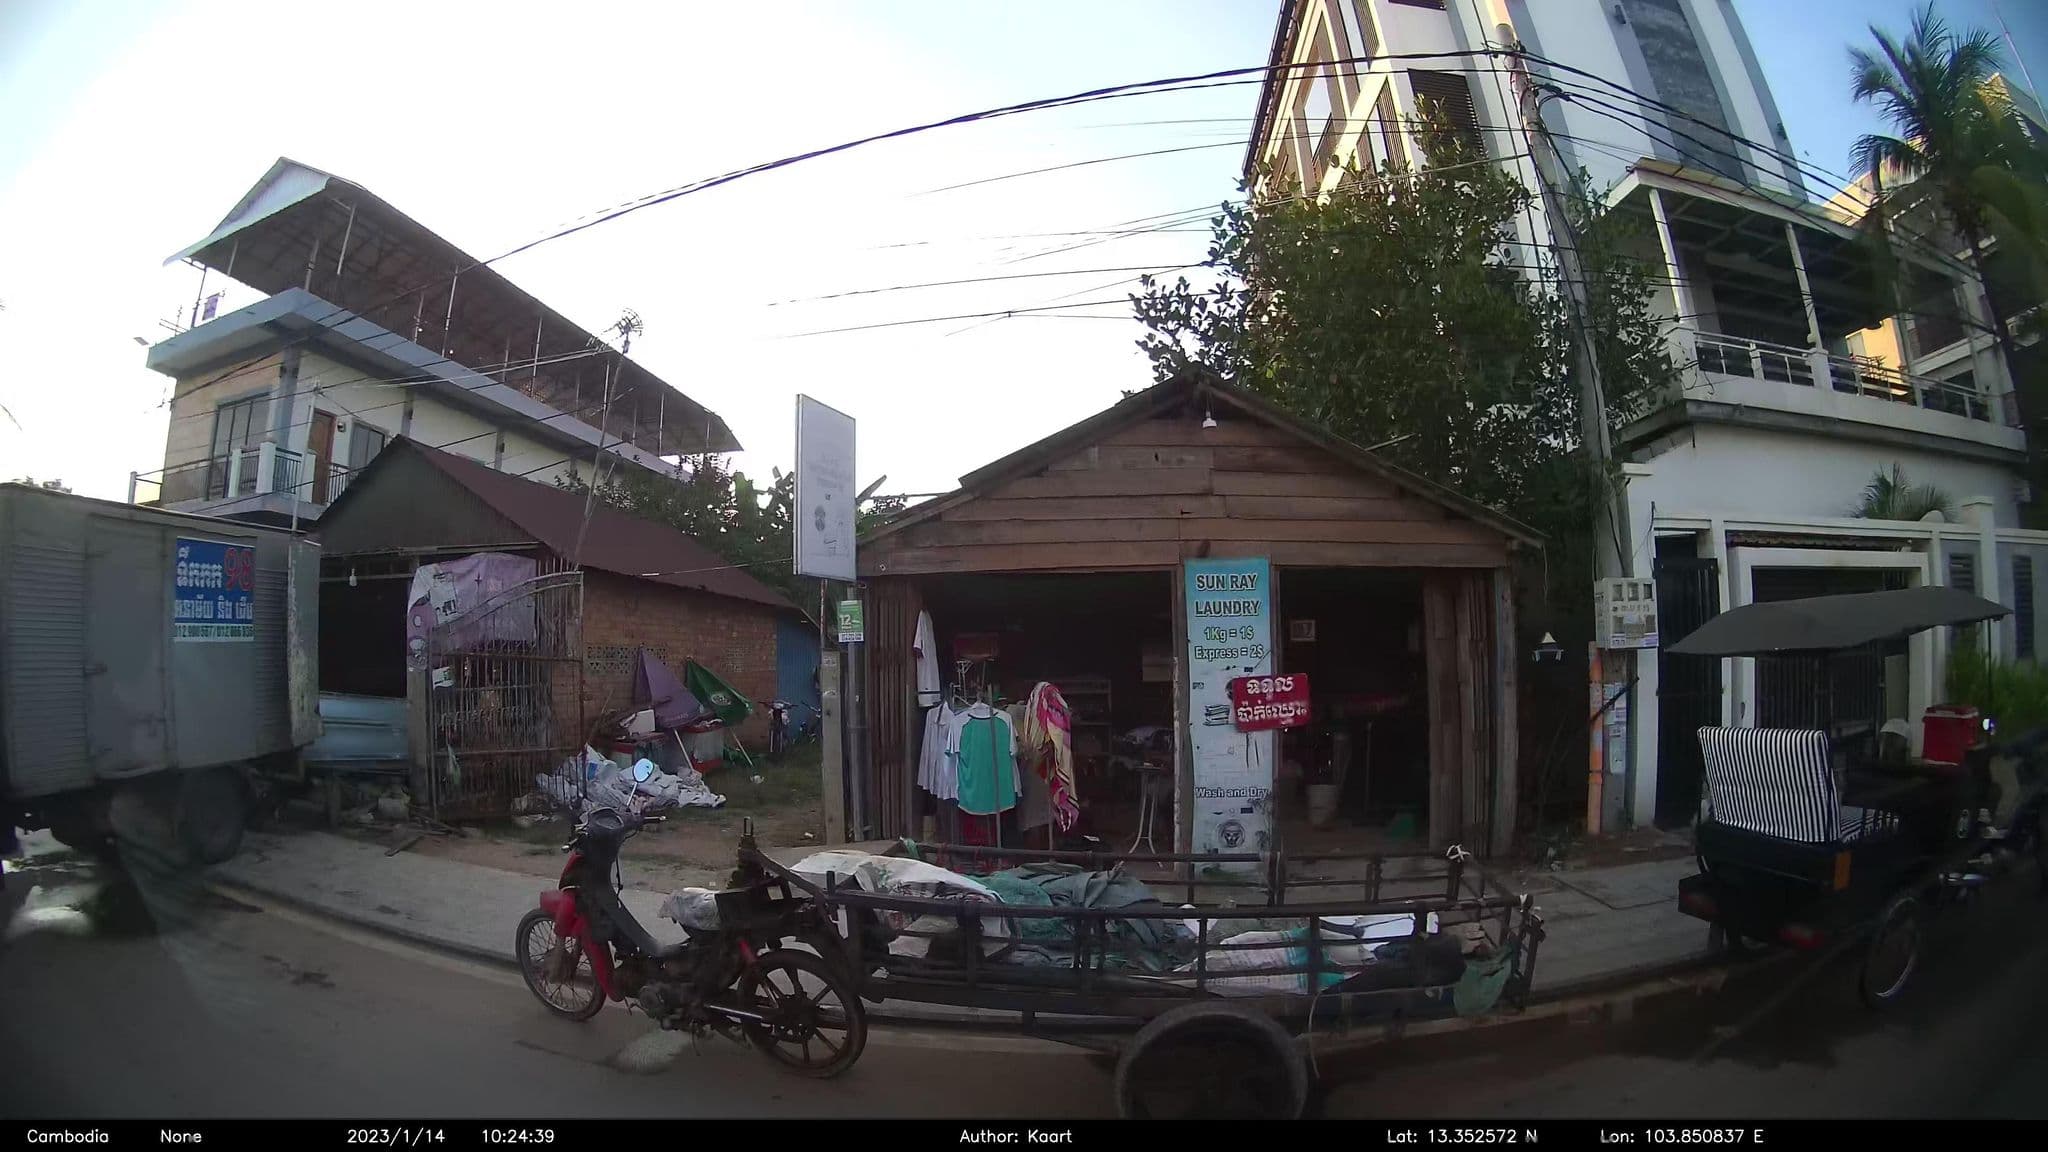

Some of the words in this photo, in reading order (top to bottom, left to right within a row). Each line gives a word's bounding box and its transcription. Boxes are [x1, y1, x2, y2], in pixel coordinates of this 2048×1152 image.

[1196, 573, 1227, 591] SUN
[1230, 573, 1258, 591] RAY
[1195, 600, 1261, 617] LAUNDRY
[1204, 626, 1228, 643] 1Kg
[1194, 645, 1239, 662] Express
[1195, 786, 1225, 798] Wash
[1226, 786, 1247, 798] and
[1249, 786, 1269, 801] Dry
